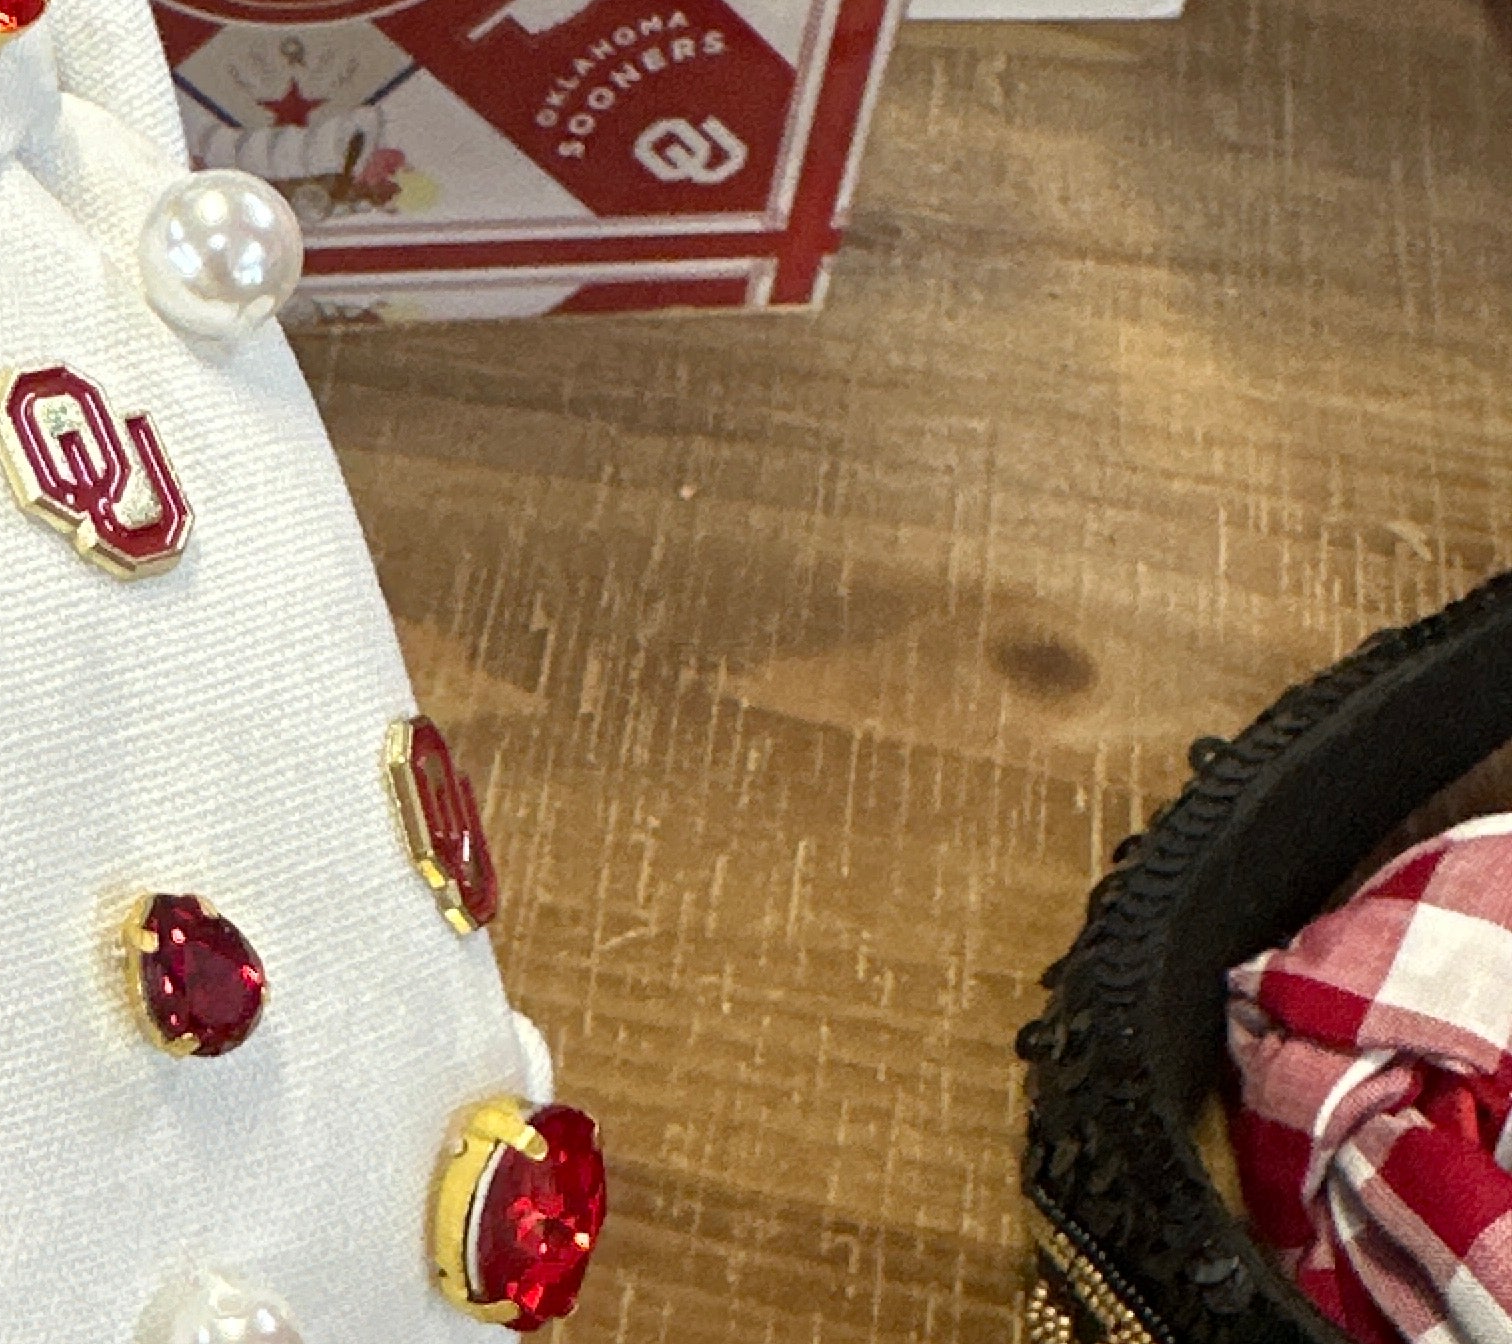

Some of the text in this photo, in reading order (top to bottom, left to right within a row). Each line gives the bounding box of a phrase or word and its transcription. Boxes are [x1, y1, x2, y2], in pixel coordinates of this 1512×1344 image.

[535, 9, 692, 129] OKLAHOMA
[559, 31, 728, 160] SOONERS
[635, 116, 749, 185] OU
